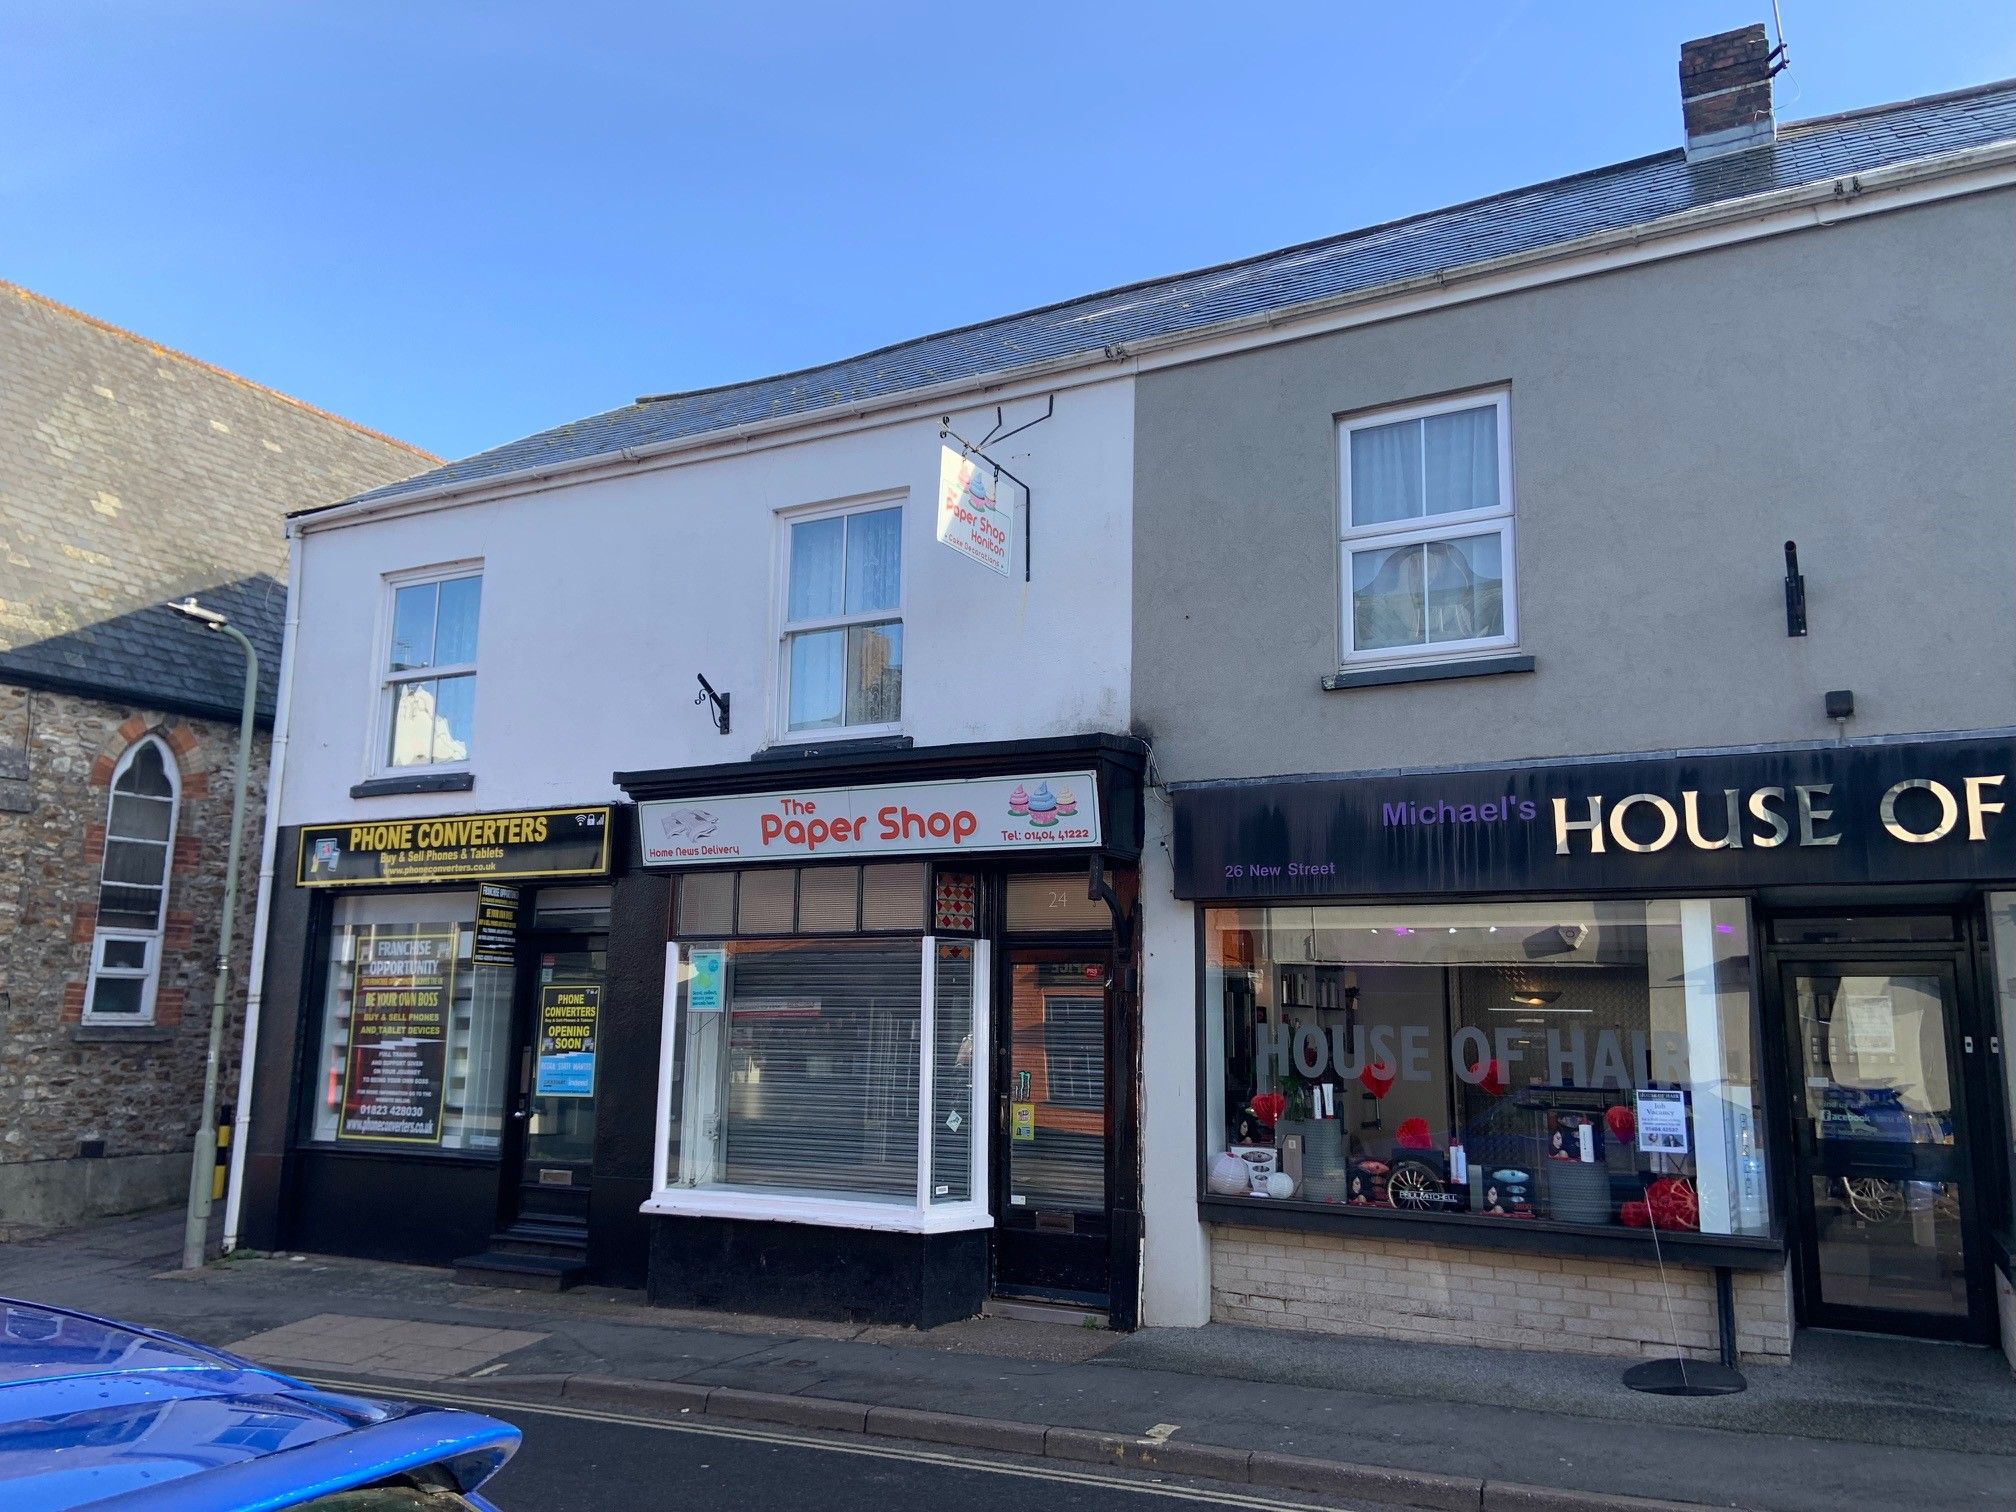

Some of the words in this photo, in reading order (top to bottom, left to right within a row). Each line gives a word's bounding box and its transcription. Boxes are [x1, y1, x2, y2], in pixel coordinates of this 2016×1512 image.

[946, 496, 977, 526] Paper
[980, 516, 1006, 545] Shop
[971, 529, 1005, 558] Honiton
[781, 799, 816, 816] The
[1382, 795, 1537, 827] Michael's
[1551, 783, 1843, 855] HOUSE
[1880, 775, 2006, 843] OF
[350, 825, 413, 852] PHONE
[417, 816, 548, 849] CONVERTERS
[760, 813, 867, 851] Paper
[877, 806, 977, 845] Shop
[1001, 830, 1022, 841] Tel:
[1024, 830, 1055, 842] 01404
[1058, 829, 1089, 840] 41222
[380, 851, 397, 865] Buy
[398, 851, 406, 863] &
[408, 851, 425, 862] Sell
[426, 849, 459, 862] Phones
[460, 848, 468, 860] &
[470, 846, 504, 859] Tablets
[649, 847, 673, 857] Home
[675, 846, 700, 856] News
[701, 844, 740, 856] Delivery
[382, 862, 496, 876] www.phoneconverters.co.uk
[1225, 865, 1244, 877] 26
[1249, 864, 1281, 877] New
[1287, 861, 1336, 876] Street
[1048, 891, 1068, 908] 24
[378, 940, 432, 956] FRANCHISE
[369, 959, 439, 975] OPPORTUNITY
[365, 992, 376, 1007] BE
[378, 992, 397, 1007] YOUR
[399, 992, 417, 1007] OWN
[418, 991, 439, 1007] BOSS
[557, 993, 584, 1004] PHONE
[363, 1013, 379, 1021] BUY
[388, 1013, 407, 1021] SELL
[408, 1013, 440, 1021] PHONES
[544, 1006, 597, 1018] CONVERTERS
[360, 1026, 377, 1035] AND
[378, 1026, 407, 1035] TABLET
[408, 1026, 441, 1035] DEVICES
[548, 1025, 590, 1038] OPENING
[555, 1037, 582, 1050] SOON
[1256, 1022, 1432, 1082] HOUSE
[1452, 1025, 1528, 1085] OF
[1547, 1027, 1692, 1091] HAIR
[360, 1105, 387, 1115] 01823
[389, 1105, 423, 1117] 428030
